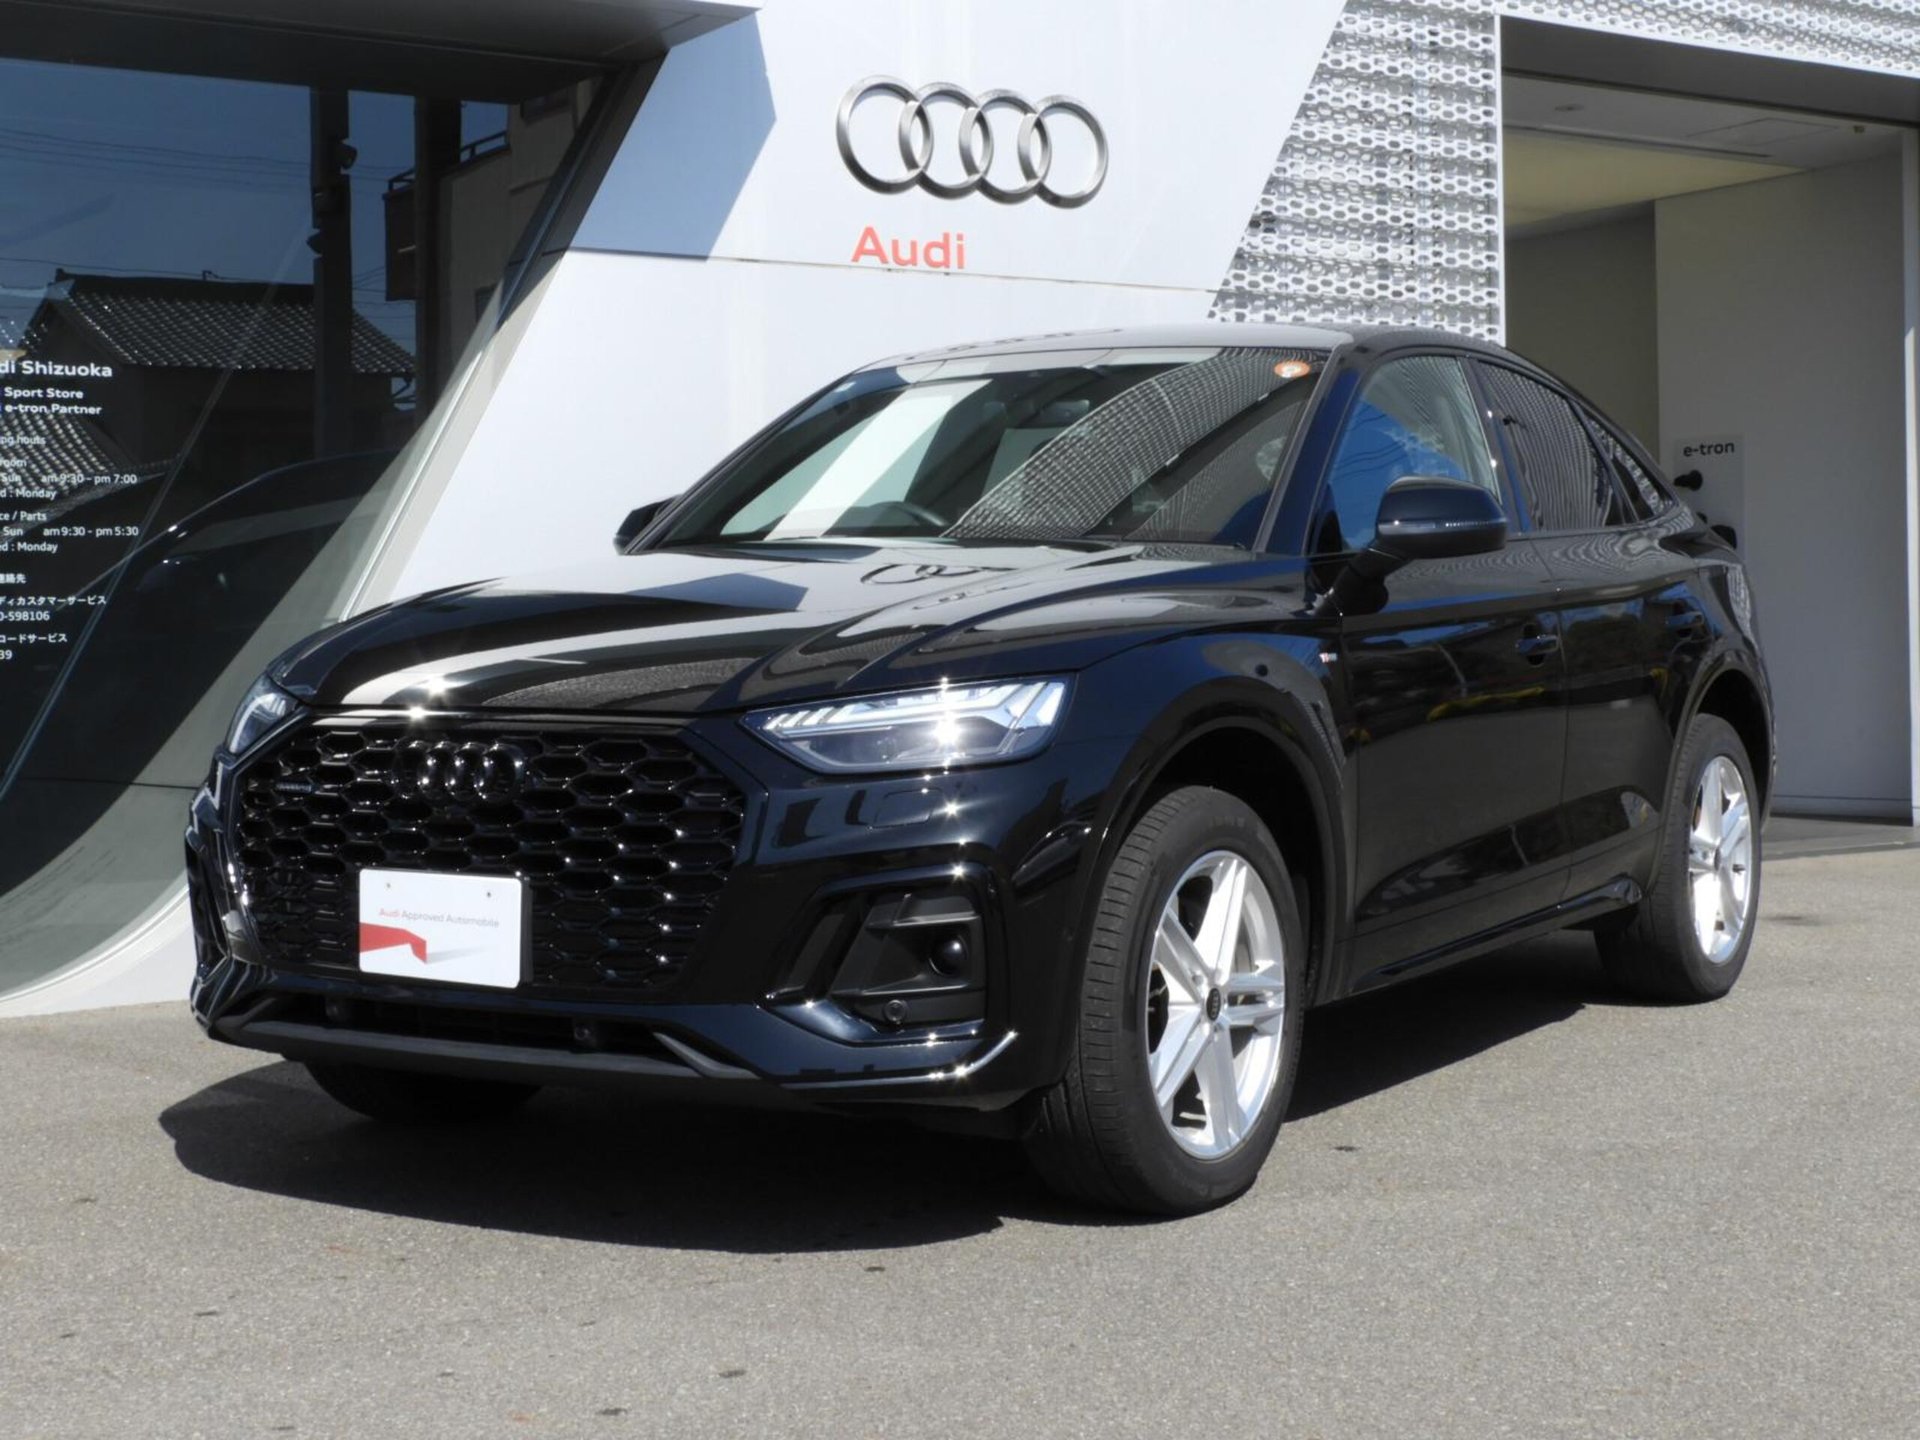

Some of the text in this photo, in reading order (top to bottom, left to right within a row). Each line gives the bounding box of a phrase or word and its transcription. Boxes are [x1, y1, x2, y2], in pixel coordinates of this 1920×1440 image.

[851, 225, 966, 269] Audi
[21, 360, 113, 377] Shizuoka
[4, 386, 84, 399] Sport Store
[4, 403, 102, 415] e-tron Partner
[1683, 442, 1735, 457] e-tron
[113, 474, 138, 484] 7:00
[15, 488, 57, 501] Monday
[20, 511, 47, 521] Parts
[3, 526, 24, 537] Sun
[114, 526, 139, 537] 5:30
[17, 542, 58, 554] Monday
[379, 907, 500, 928] Audi Approved Automobile
